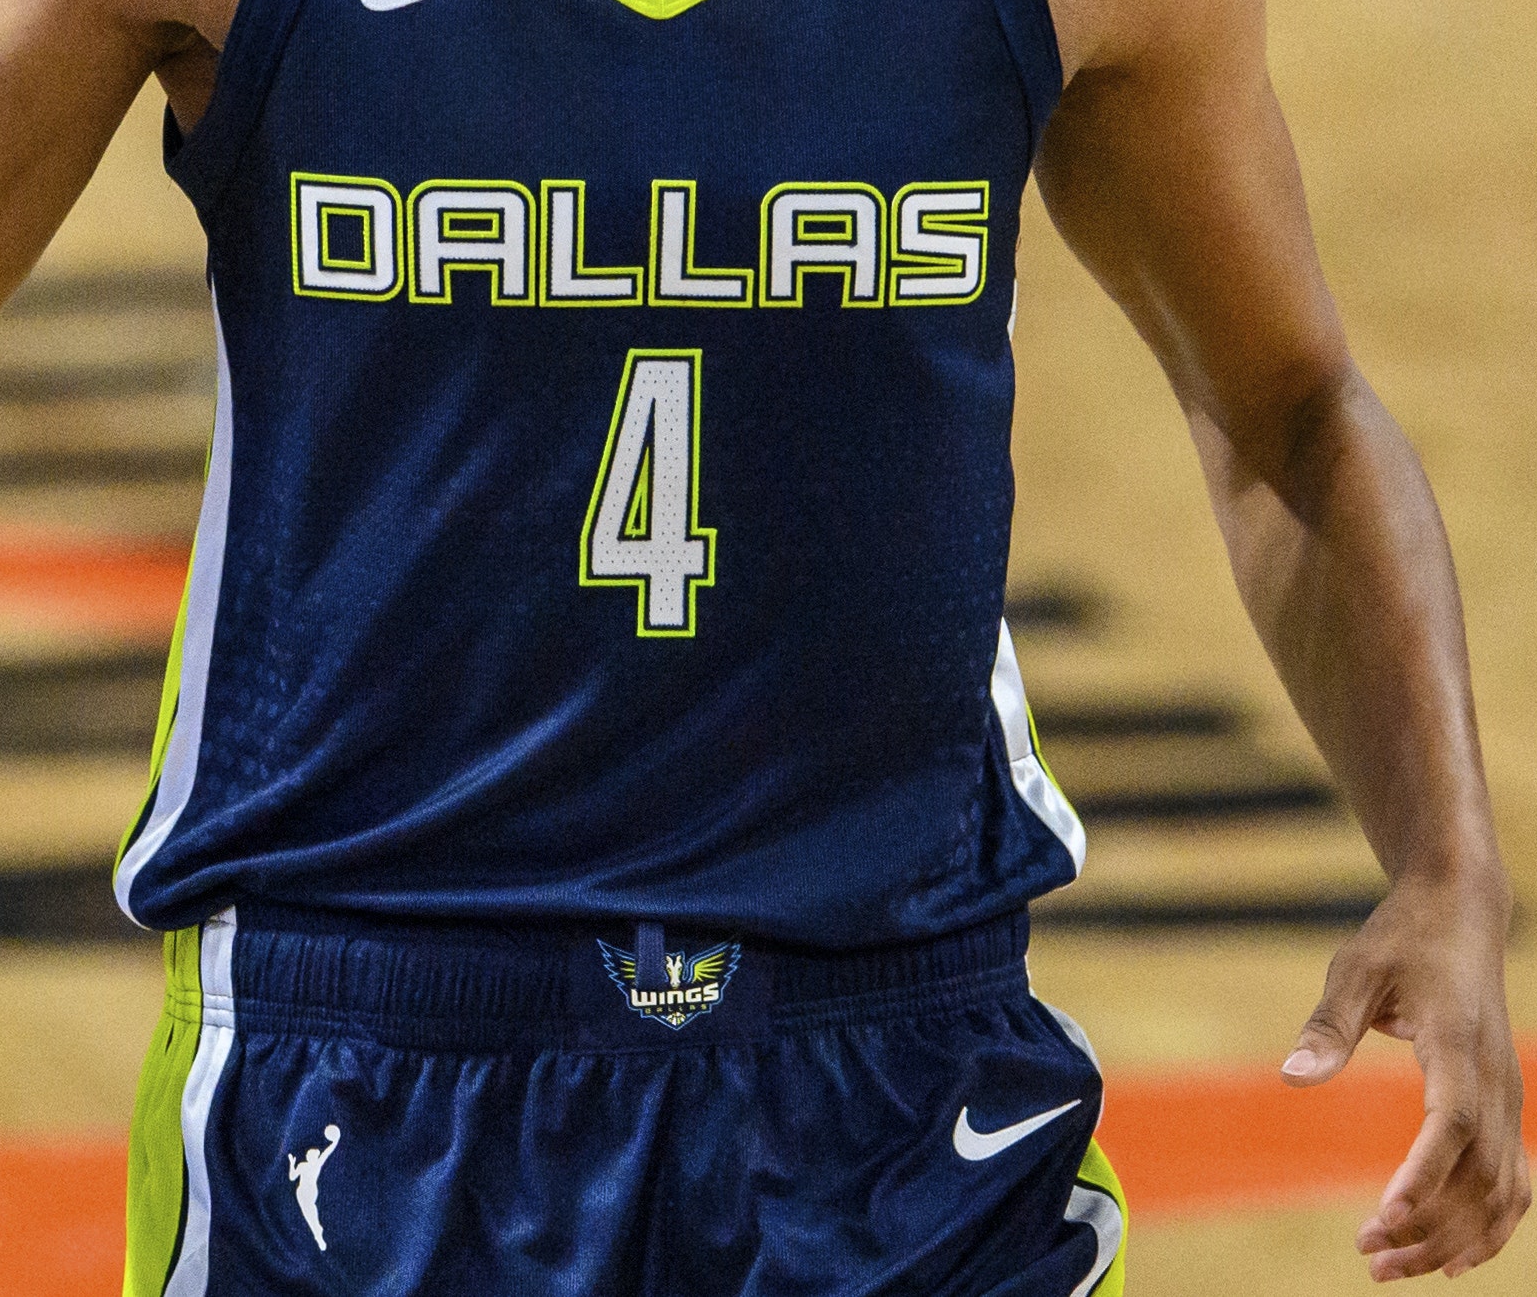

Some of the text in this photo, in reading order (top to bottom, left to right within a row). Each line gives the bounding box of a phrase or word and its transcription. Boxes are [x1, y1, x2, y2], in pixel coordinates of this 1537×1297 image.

[291, 172, 990, 308] DALLAS
[579, 348, 716, 638] 4
[630, 982, 720, 1007] WINGS
[644, 1004, 708, 1014] DALLAS
